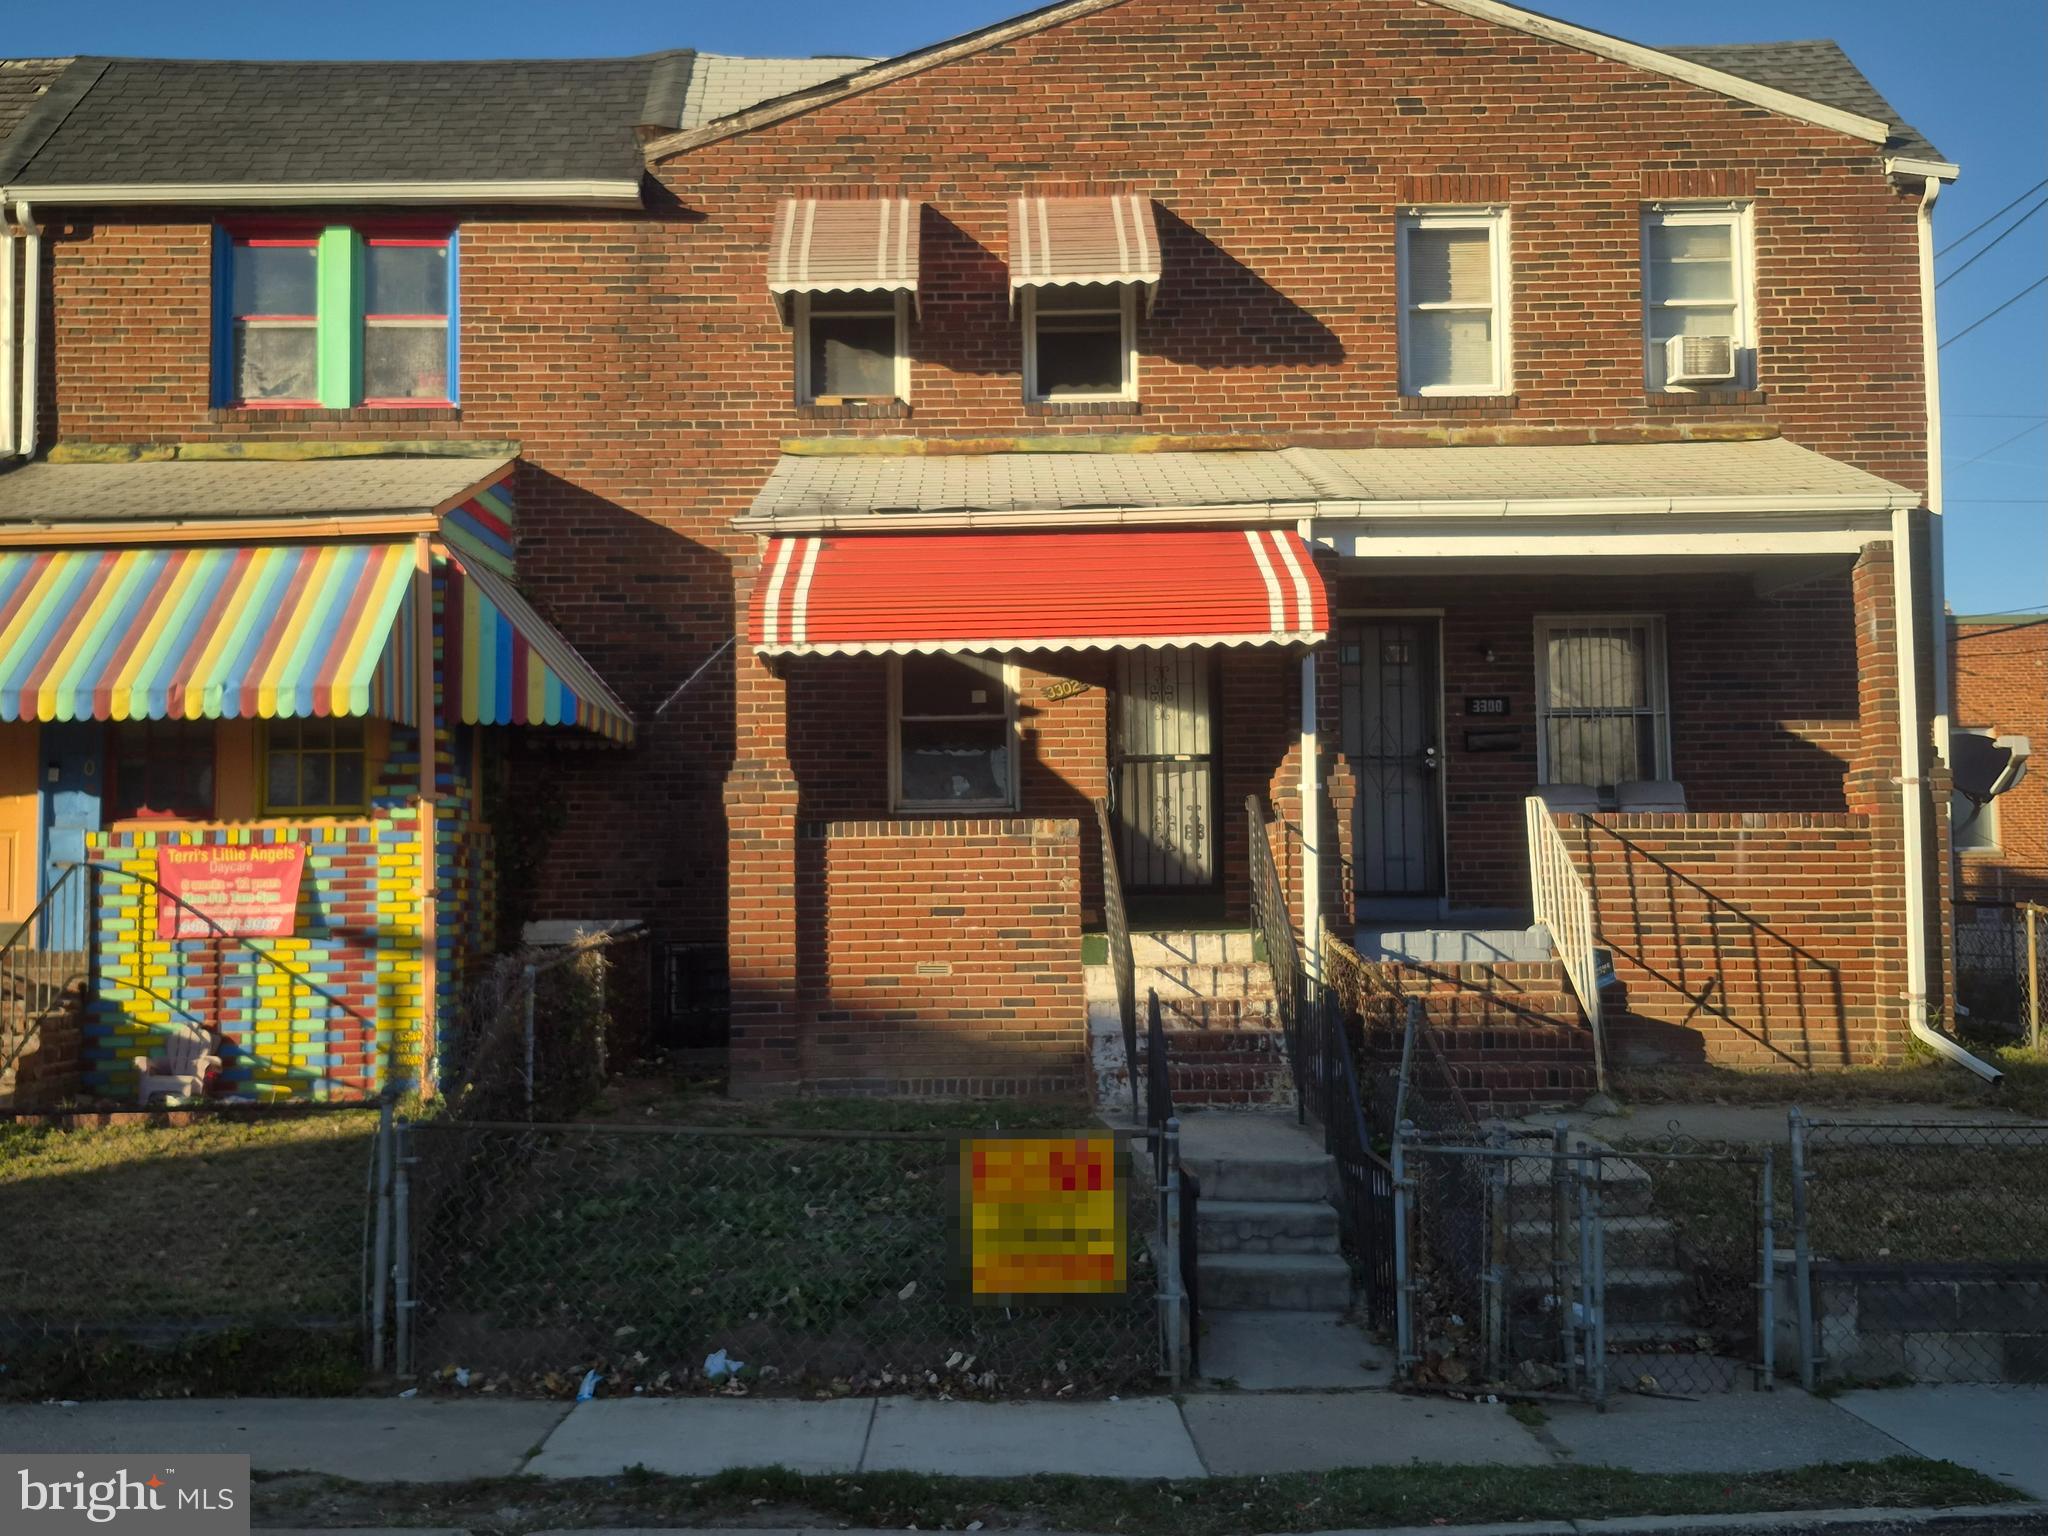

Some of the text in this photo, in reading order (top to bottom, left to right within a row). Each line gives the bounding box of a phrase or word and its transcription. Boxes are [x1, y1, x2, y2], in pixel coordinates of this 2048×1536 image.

[1046, 680, 1080, 698] 3302
[168, 847, 295, 863] Terri's Little Angels
[209, 861, 253, 875] Daycare
